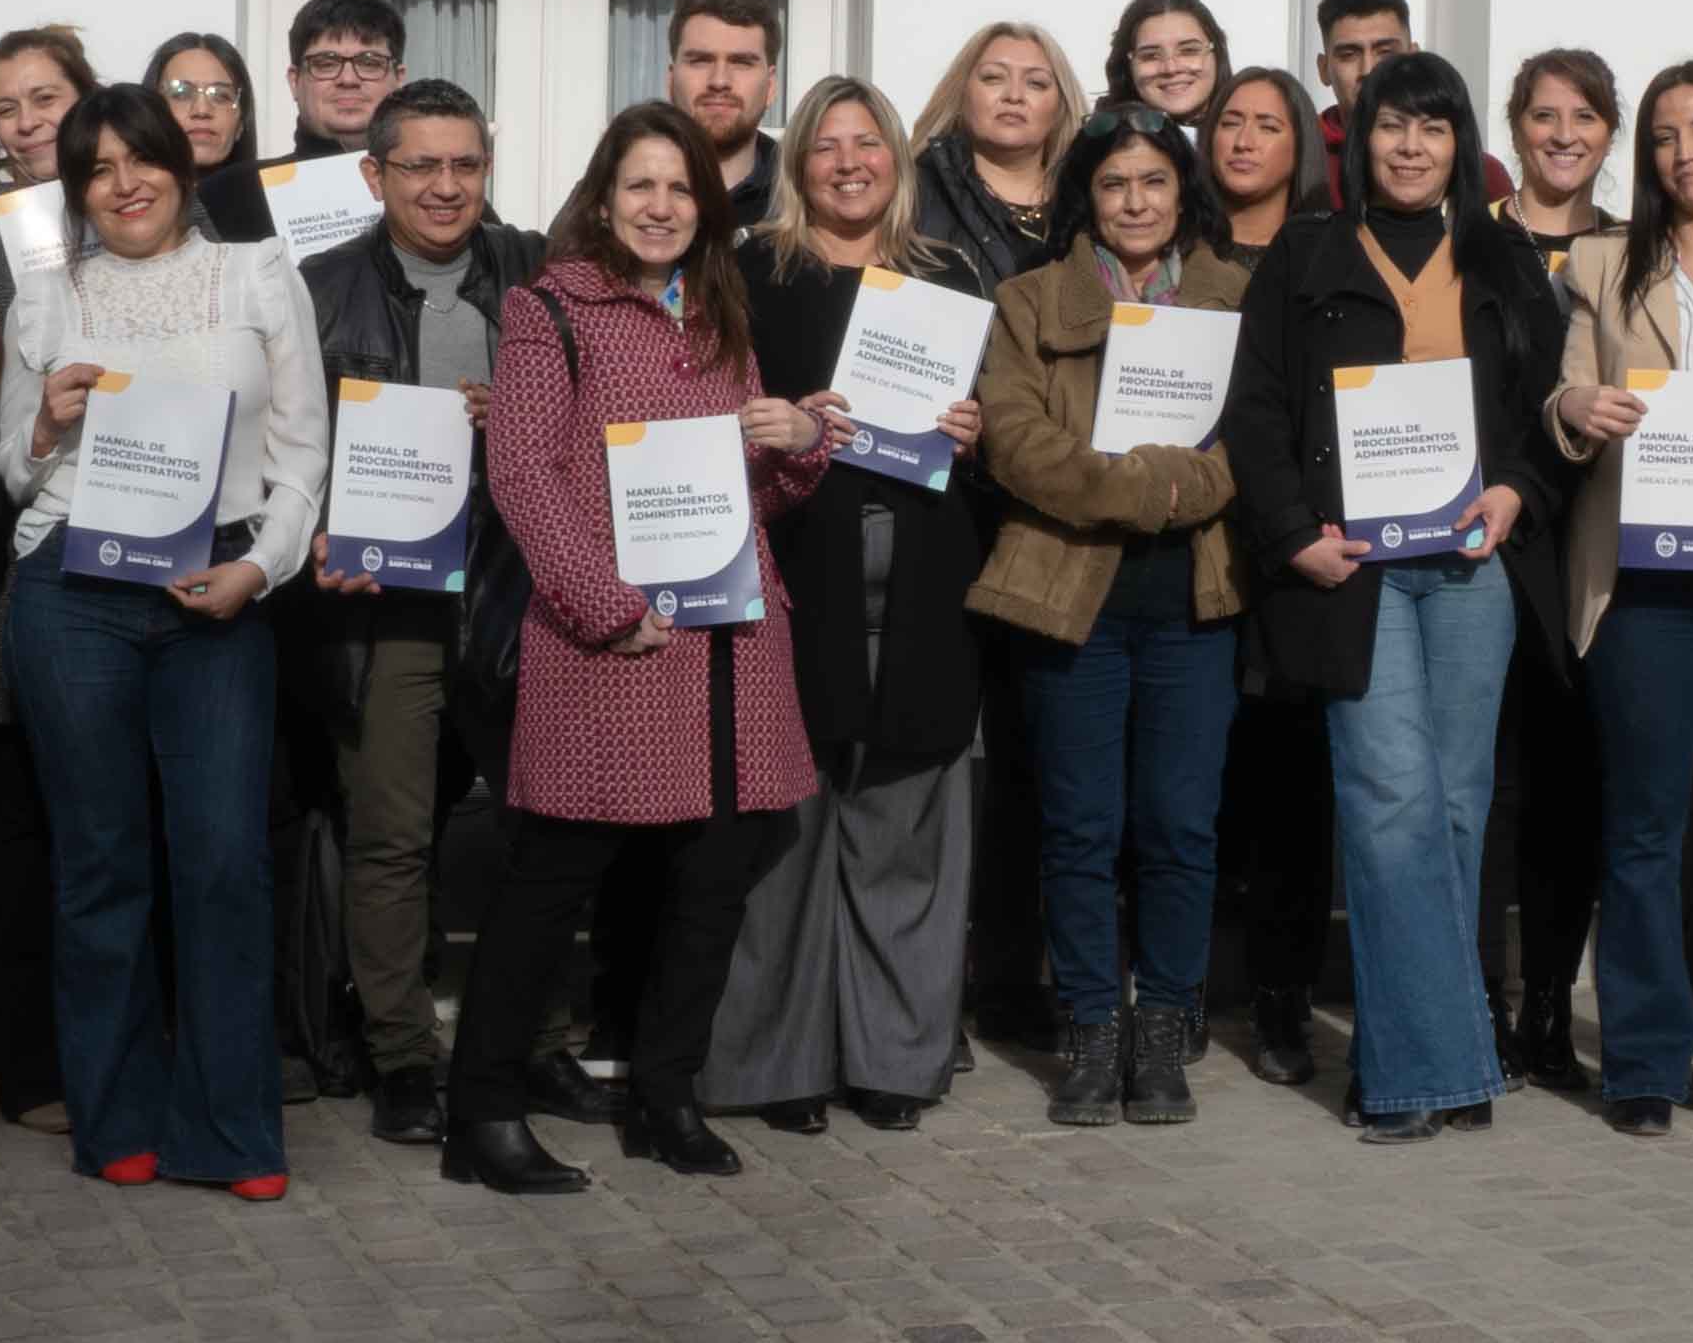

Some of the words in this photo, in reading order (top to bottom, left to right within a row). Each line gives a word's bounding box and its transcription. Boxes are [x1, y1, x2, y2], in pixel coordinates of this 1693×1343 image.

[288, 213, 332, 225] MANUAL
[862, 327, 909, 349] MANUAL
[912, 342, 927, 354] DE
[859, 338, 956, 376] PROCEDIMIENTOS
[855, 349, 955, 386] ADMINISTRATIVOS
[1120, 365, 1166, 378] MANUAL
[1170, 370, 1185, 379] DE
[1119, 376, 1213, 391] PROCEDIMIENTOS
[1117, 387, 1213, 401] ADMINISTRATIVOS
[1353, 426, 1402, 437] MANUAL
[1405, 424, 1421, 433] DE
[1640, 433, 1688, 442] MANUAL
[94, 434, 145, 449] MANUAL
[149, 442, 166, 452] DE
[1354, 432, 1457, 448] PROCEDIMIENTOS
[93, 446, 200, 471] PROCEDIMIENTOS
[350, 444, 400, 456] MANUAL
[403, 448, 418, 458] DE
[1355, 444, 1460, 460] ADMINISTRATIVOS
[91, 458, 201, 483] ADMINISTRATIVOS
[349, 455, 452, 473] PROCEDIMIENTOS
[347, 467, 454, 485] ADMINISTRATIVOS
[626, 486, 674, 497] MANUAL
[677, 484, 693, 494] DE
[627, 494, 729, 509] PROCEDIMIENTOS
[628, 505, 732, 521] ADMINISTRATIVOS
